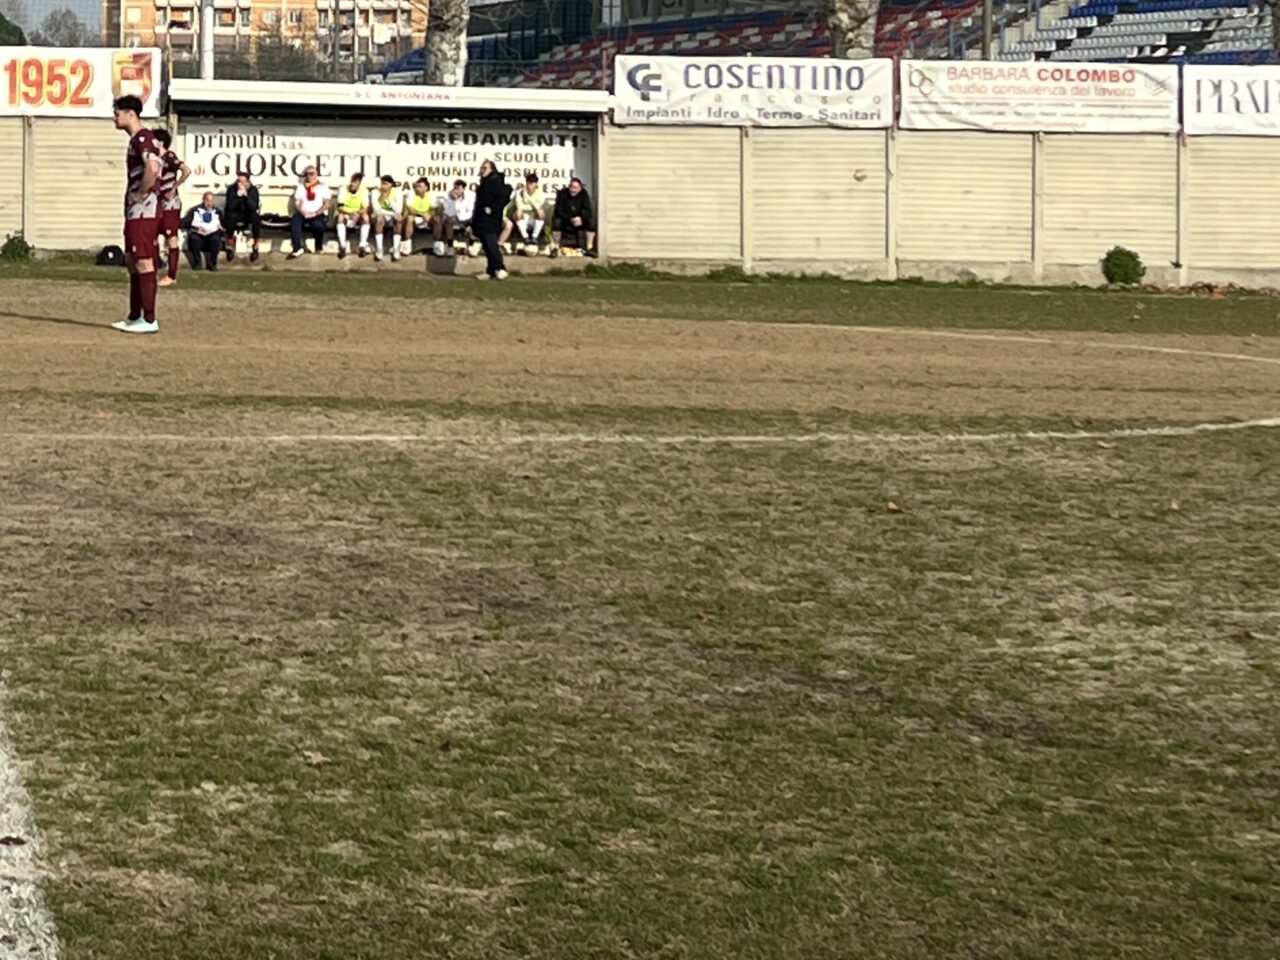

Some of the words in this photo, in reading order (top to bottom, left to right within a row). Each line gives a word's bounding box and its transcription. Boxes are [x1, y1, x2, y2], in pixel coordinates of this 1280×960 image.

[947, 66, 1031, 81] BARBARA
[1037, 68, 1136, 83] COLOMBO
[4, 58, 94, 107] 1952
[1094, 85, 1136, 97] lavoro
[626, 106, 692, 121] Impianti
[707, 107, 740, 119] Idro
[756, 108, 804, 120] Termo
[818, 109, 882, 121] Sanitari
[194, 129, 276, 153] primula
[431, 151, 477, 162] UFFICI
[494, 152, 551, 163] SCUOLE
[406, 166, 484, 177] COMUNIT
